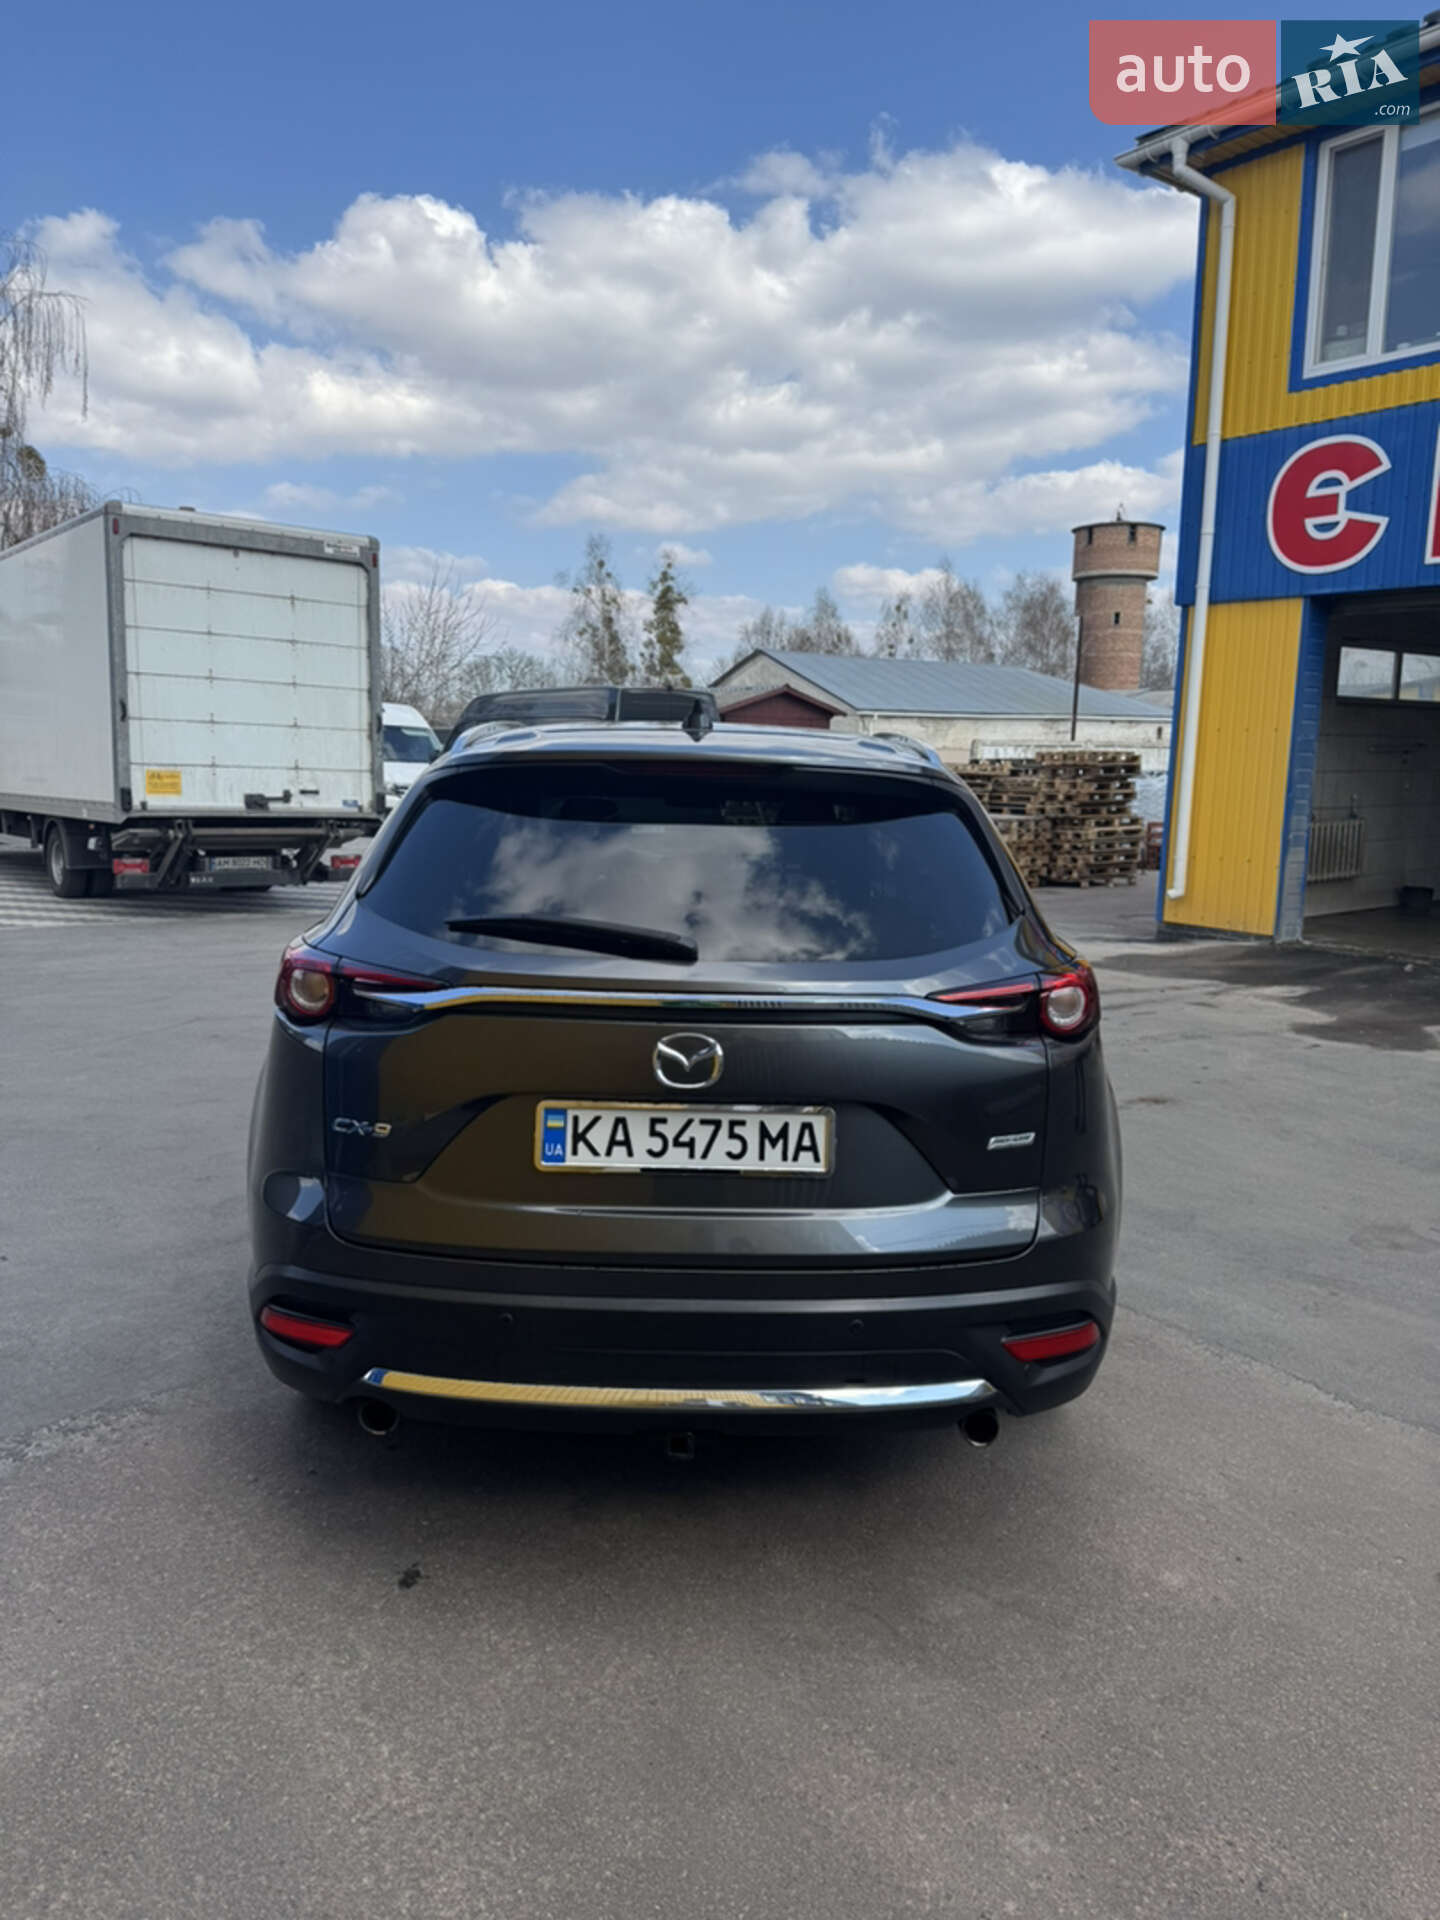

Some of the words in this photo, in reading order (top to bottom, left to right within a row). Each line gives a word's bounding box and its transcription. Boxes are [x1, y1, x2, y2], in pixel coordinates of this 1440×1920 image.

[1267, 422, 1440, 575] Є
[334, 1117, 392, 1138] CX-9
[571, 1114, 634, 1158] KA
[645, 1116, 748, 1161] 5475
[757, 1119, 821, 1163] MA
[545, 1143, 563, 1157] UA
